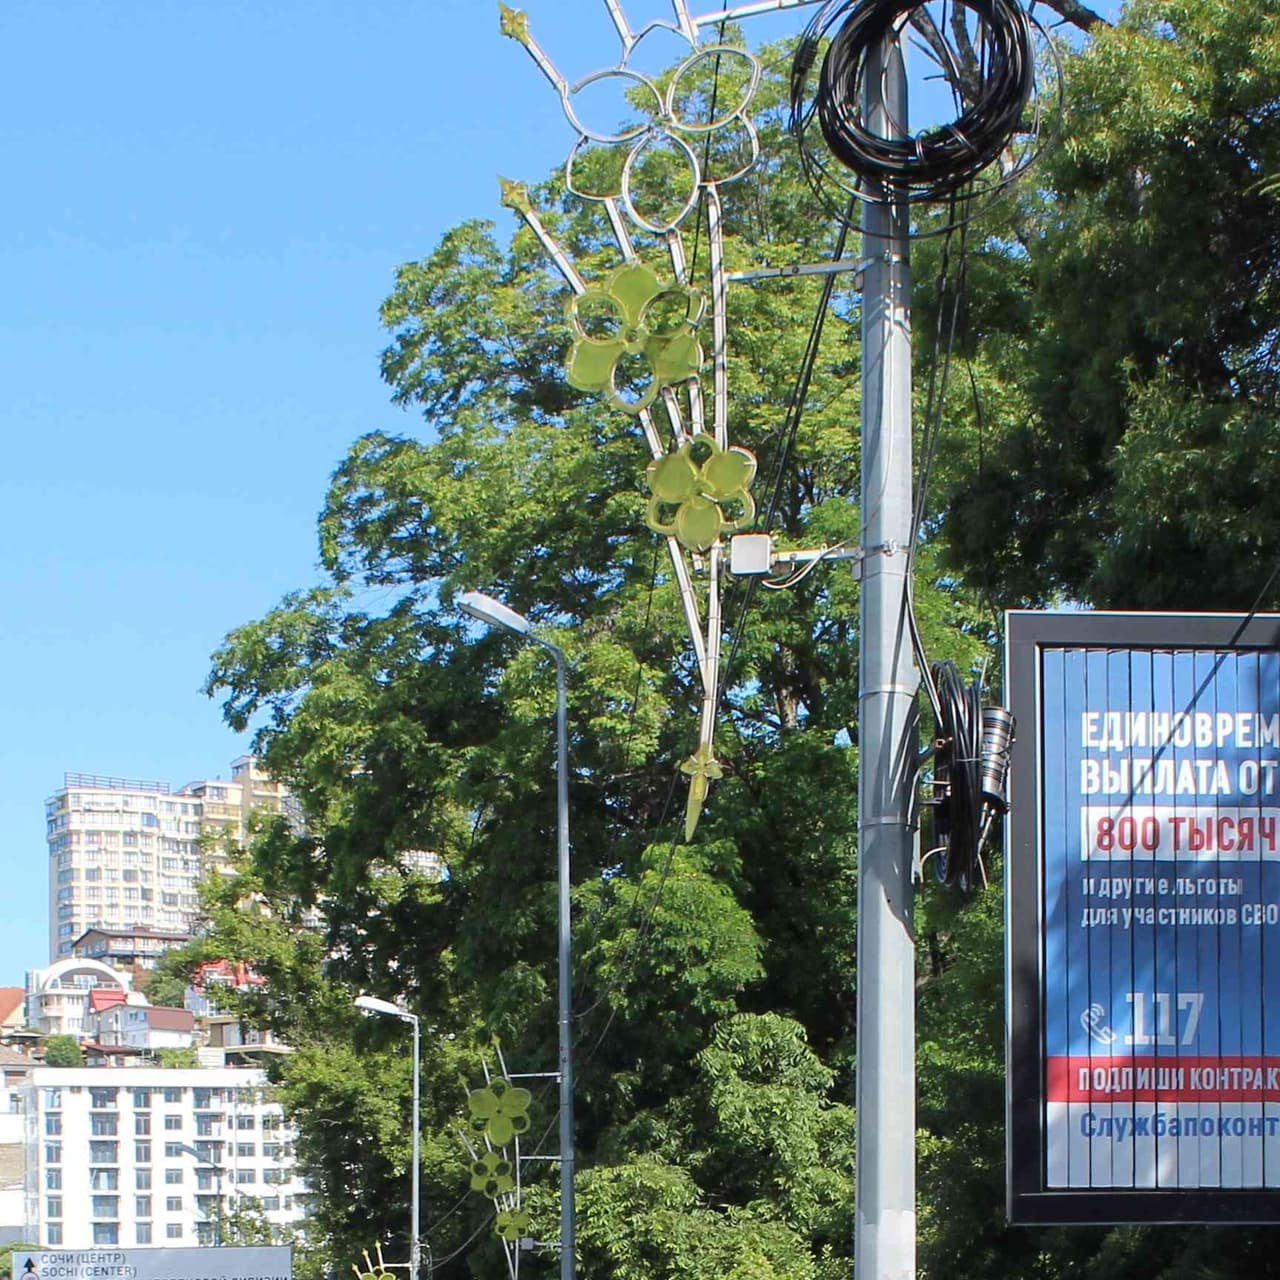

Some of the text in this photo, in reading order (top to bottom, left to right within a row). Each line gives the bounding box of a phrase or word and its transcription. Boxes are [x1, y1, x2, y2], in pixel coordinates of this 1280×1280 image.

[1080, 759, 1278, 795] ВЫПЛАТА ОТ
[1097, 816, 1160, 852] 800
[1168, 818, 1276, 852] ТЫСЯЧ
[1082, 878, 1243, 899] и другие льготы
[1081, 904, 1279, 929] для участников СВО
[1124, 992, 1204, 1046] 117
[1078, 1068, 1184, 1093] ПОДПИШИ
[41, 1253, 126, 1265] СОЧИ (ЦЕНТР)
[41, 1266, 137, 1278] SOCHI (CENTER)
